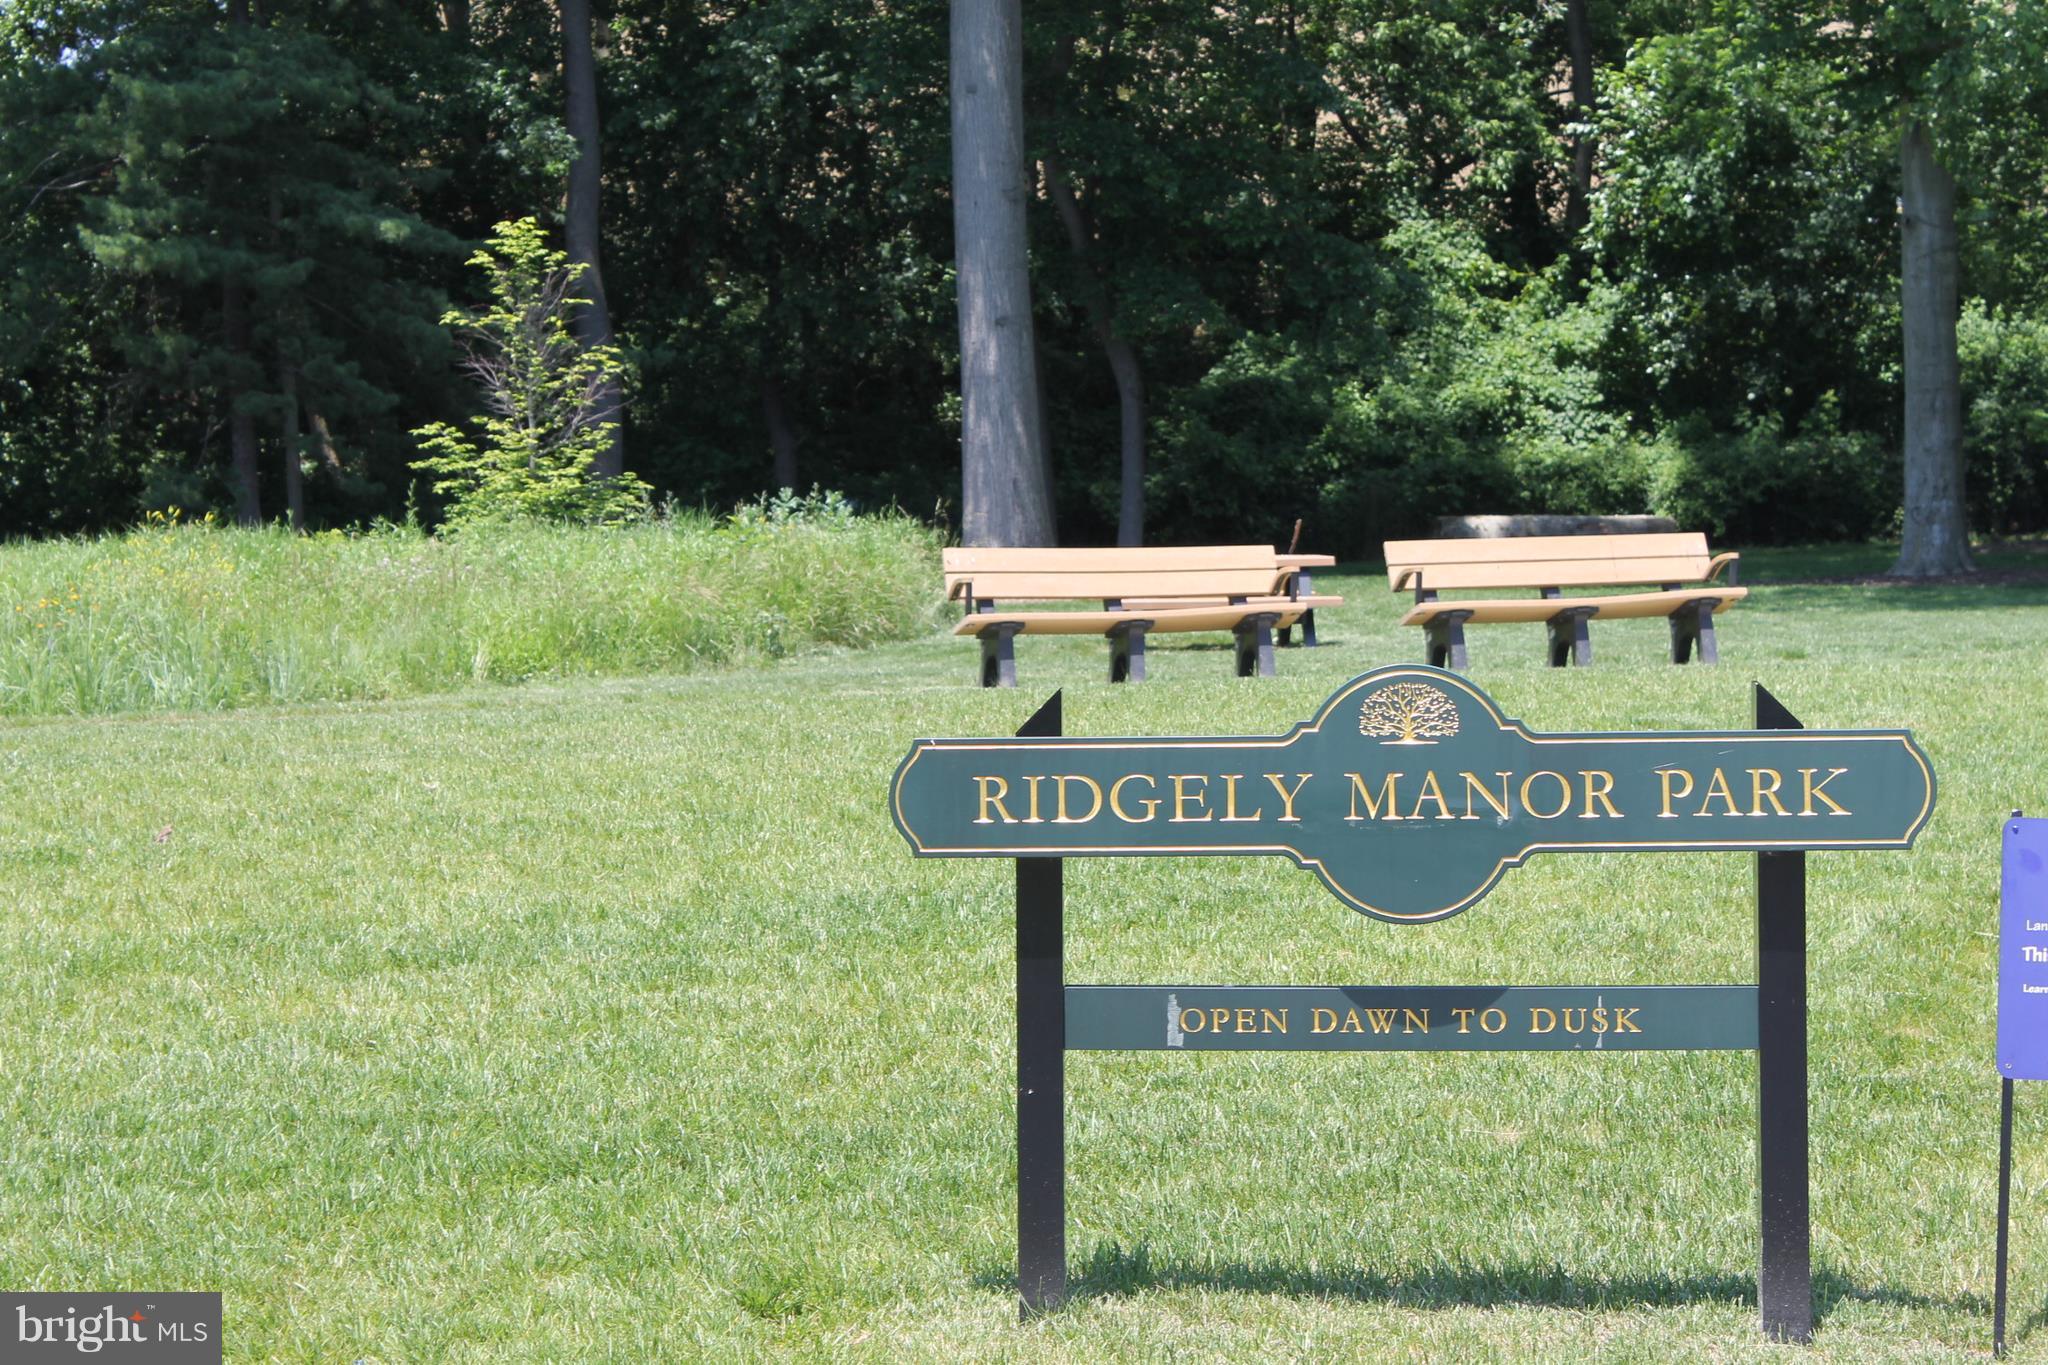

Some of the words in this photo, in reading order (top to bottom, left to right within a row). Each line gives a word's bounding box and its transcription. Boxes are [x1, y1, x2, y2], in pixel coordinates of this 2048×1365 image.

[972, 773, 1313, 825] RIDGELY
[1343, 769, 1624, 821] MANOR
[1654, 767, 1852, 817] PARK
[2022, 946, 2048, 962] Thi
[1180, 1007, 1289, 1034] OPEN
[1310, 1007, 1429, 1034] DAWN
[1452, 1007, 1508, 1034] TO
[1529, 1007, 1643, 1034] DUSK
